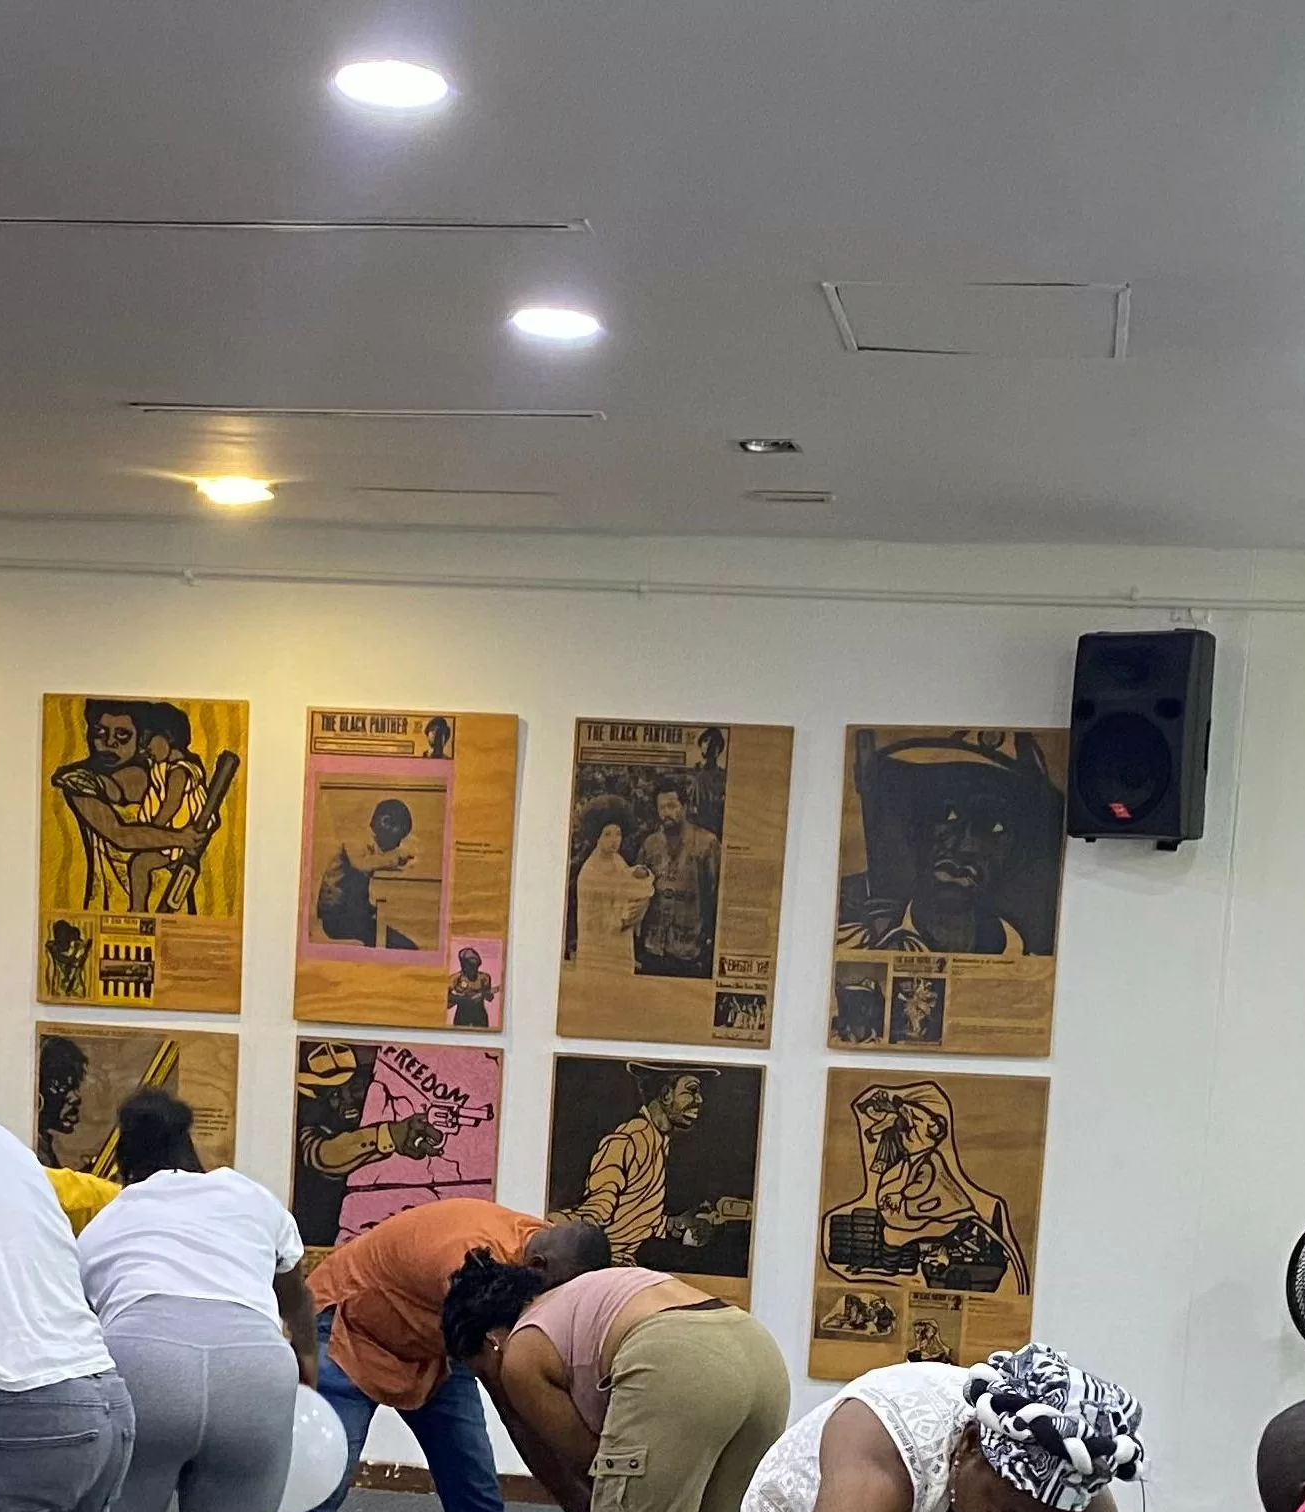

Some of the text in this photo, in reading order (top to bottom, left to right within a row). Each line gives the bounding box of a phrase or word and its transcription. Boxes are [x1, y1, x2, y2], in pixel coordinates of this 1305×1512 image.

[321, 714, 407, 735] THE BLACK PANTHER
[587, 725, 683, 743] THE BLACK PANTHER
[383, 1045, 470, 1107] FREEDOM
